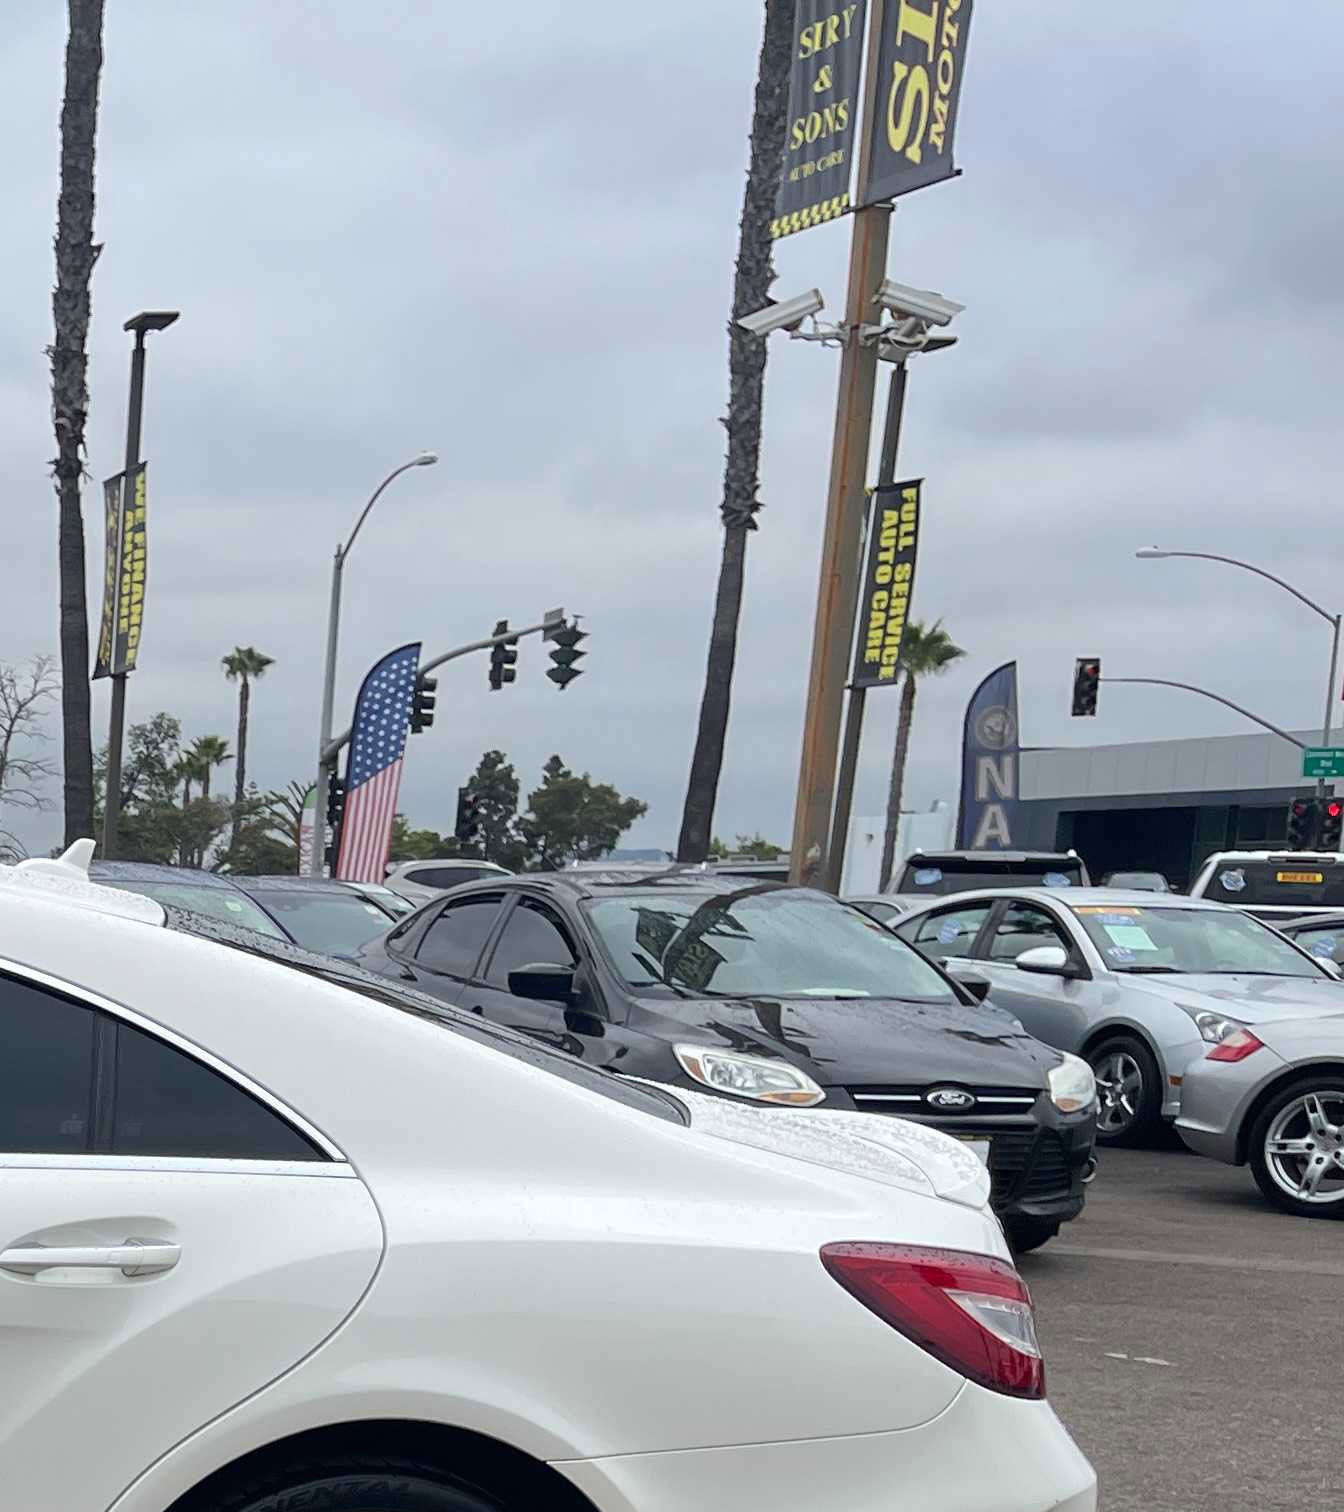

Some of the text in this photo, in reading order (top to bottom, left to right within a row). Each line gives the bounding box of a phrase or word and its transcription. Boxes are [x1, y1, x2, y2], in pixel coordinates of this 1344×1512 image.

[799, 5, 857, 59] SIRY
[813, 65, 832, 93] &
[928, 0, 962, 155] MOT
[789, 98, 850, 150] SONS
[118, 509, 135, 635] ANYONE
[125, 471, 146, 667] WE FINANCE
[864, 509, 900, 664] AUTO CARE
[878, 486, 918, 681] FULL SERVICE
